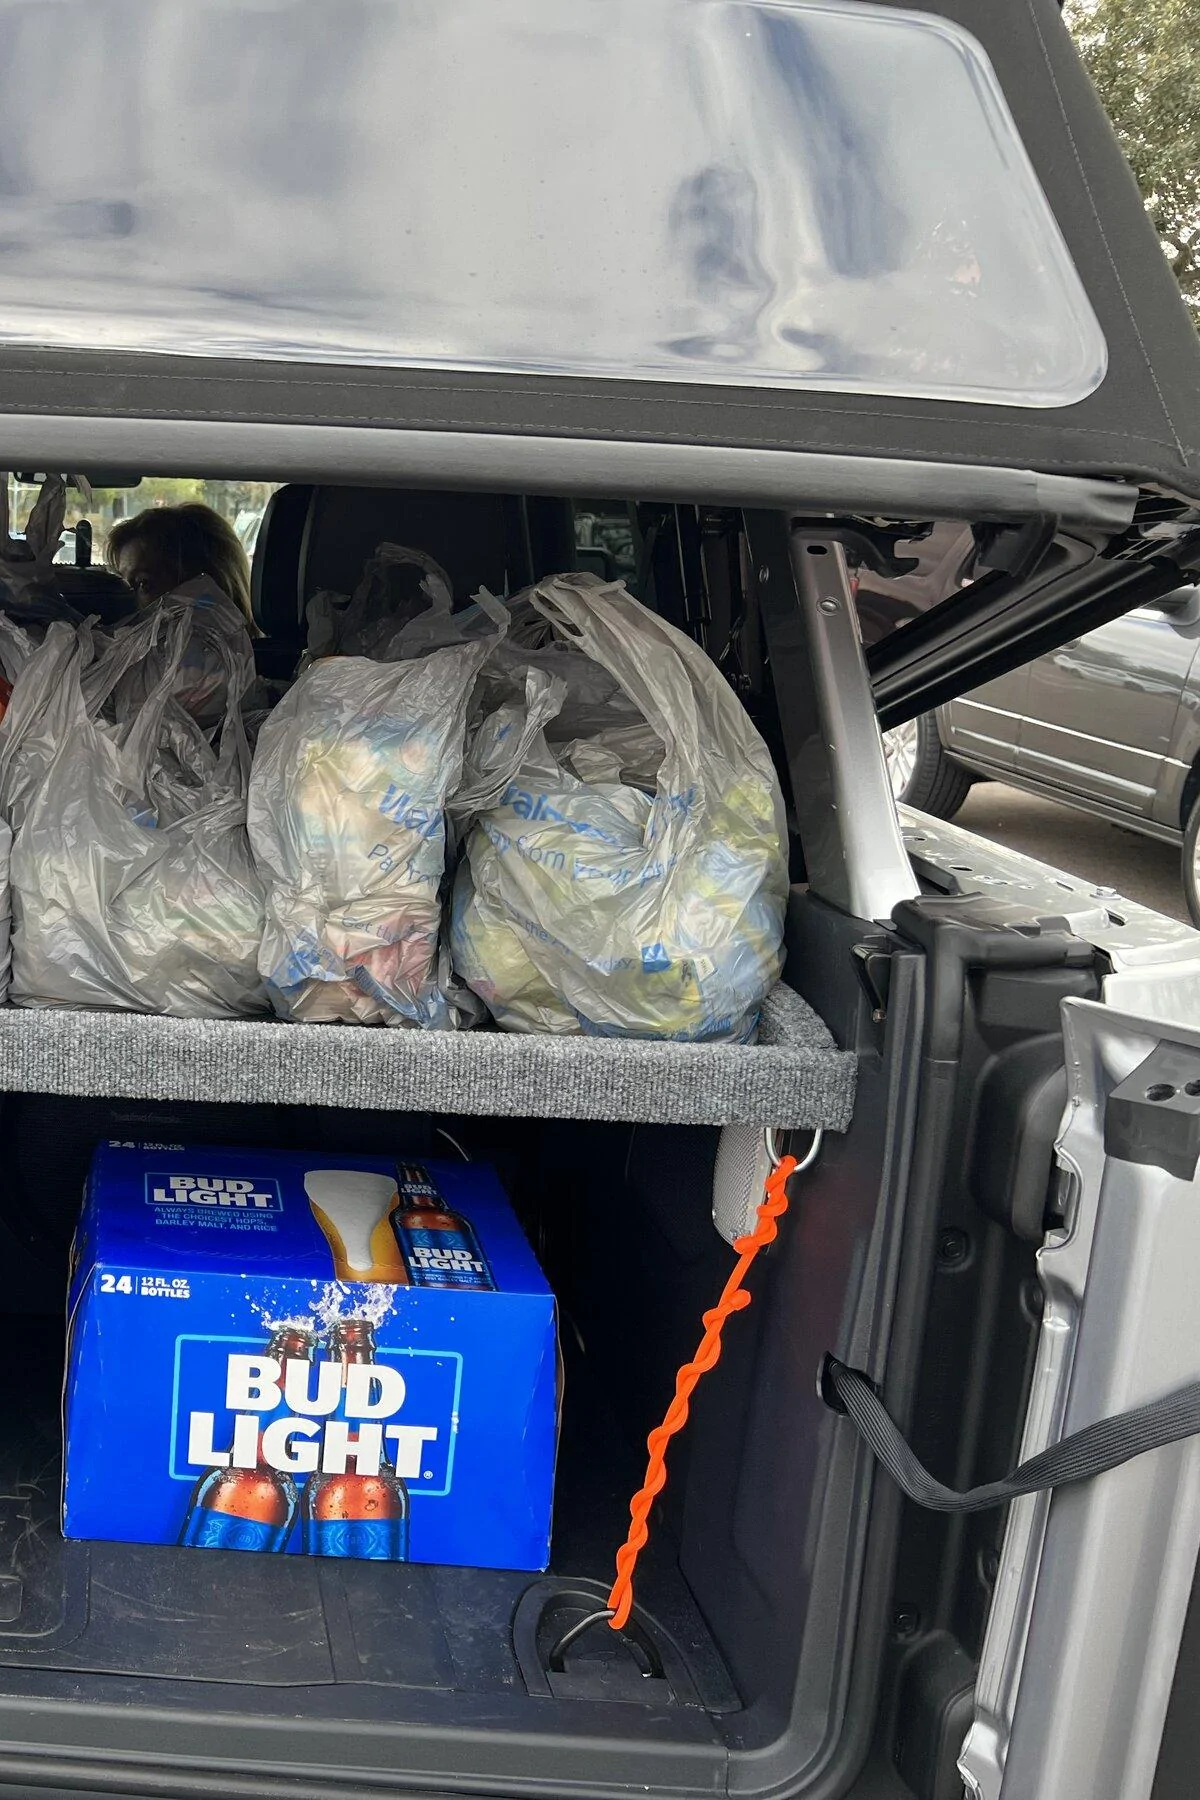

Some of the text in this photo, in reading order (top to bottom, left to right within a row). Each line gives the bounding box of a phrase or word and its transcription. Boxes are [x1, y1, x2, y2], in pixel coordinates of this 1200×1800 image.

[169, 1176, 255, 1194] BUD
[154, 1206, 195, 1214] ALWAYS
[242, 1211, 273, 1219] USING
[183, 1214, 233, 1223] CHOICEST
[155, 1218, 196, 1226] BARLEY
[229, 1223, 251, 1231] AND
[253, 1224, 277, 1232] RICE
[412, 1247, 473, 1261] BUD
[408, 1256, 484, 1272] LIGHT
[100, 1273, 133, 1295] 24
[141, 1276, 190, 1289] 12 FL. OZ.
[140, 1286, 191, 1299] BOTTLES
[224, 1352, 407, 1420] BUD
[187, 1411, 439, 1479] LIGHT
